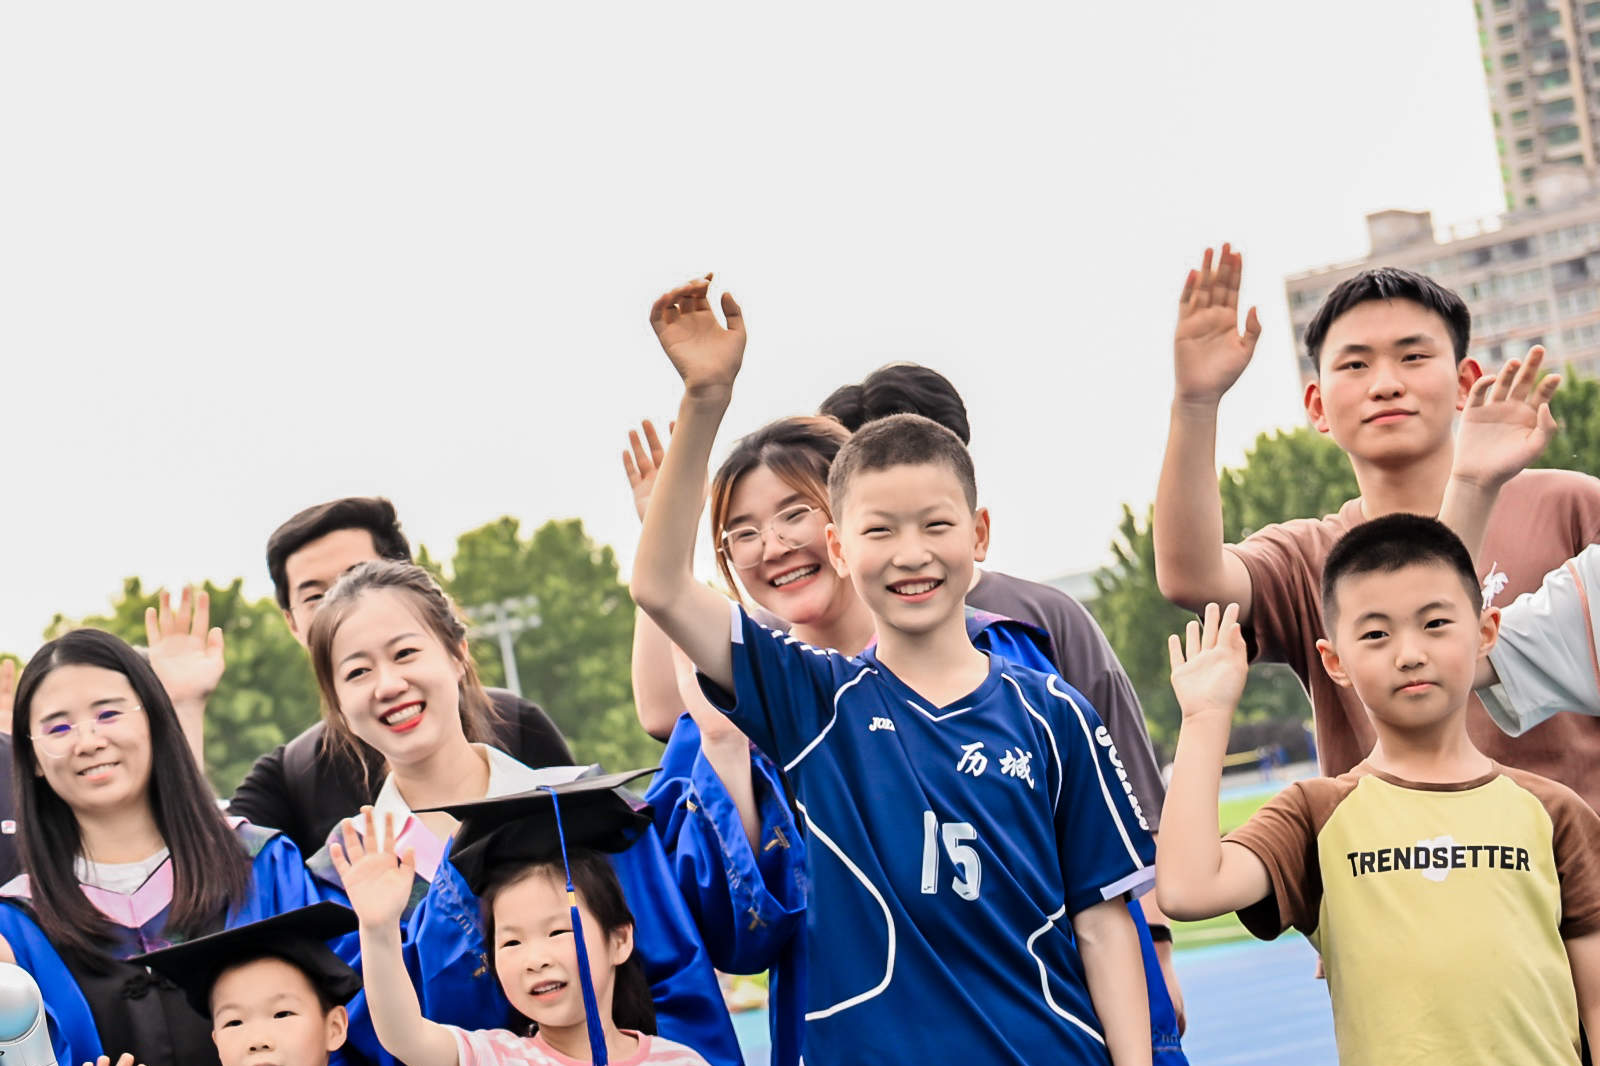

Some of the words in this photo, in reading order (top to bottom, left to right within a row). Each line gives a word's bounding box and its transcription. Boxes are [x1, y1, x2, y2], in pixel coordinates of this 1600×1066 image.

[956, 741, 1035, 790] 历城
[920, 810, 982, 901] 15
[1347, 845, 1530, 877] TRENDSETTER
